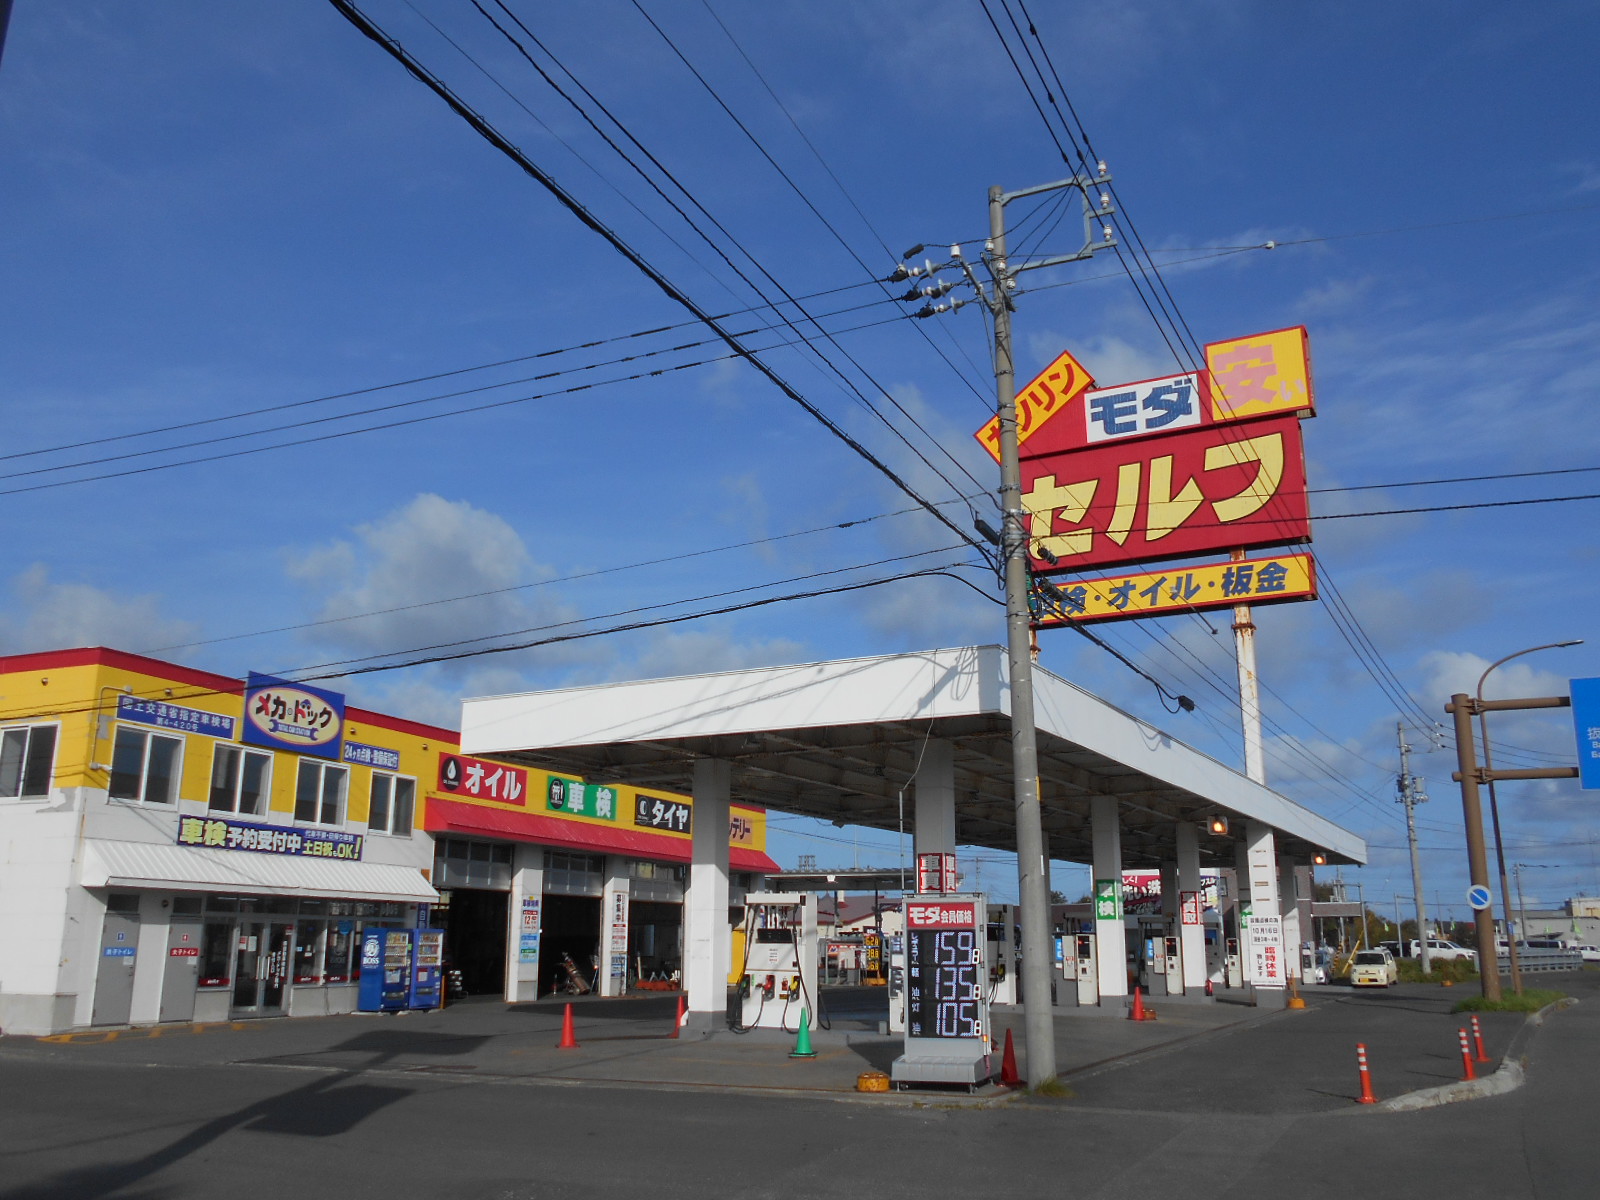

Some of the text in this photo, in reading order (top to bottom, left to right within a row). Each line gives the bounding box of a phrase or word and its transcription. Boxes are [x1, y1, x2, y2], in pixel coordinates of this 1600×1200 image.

[1212, 344, 1306, 413] 安い
[1090, 379, 1193, 435] モダ
[1021, 432, 1285, 560] セルフ
[122, 698, 231, 729] 国土交通省指定車検場
[465, 763, 522, 800] オイル
[567, 783, 612, 818] 車検
[652, 800, 689, 830] タイヤ
[181, 818, 302, 853] 車検予約受付中
[934, 931, 974, 965] 159
[1252, 927, 1278, 935] 10月16日
[362, 957, 380, 965] BOSS
[935, 966, 974, 1000] 135
[936, 1002, 975, 1036] 105
